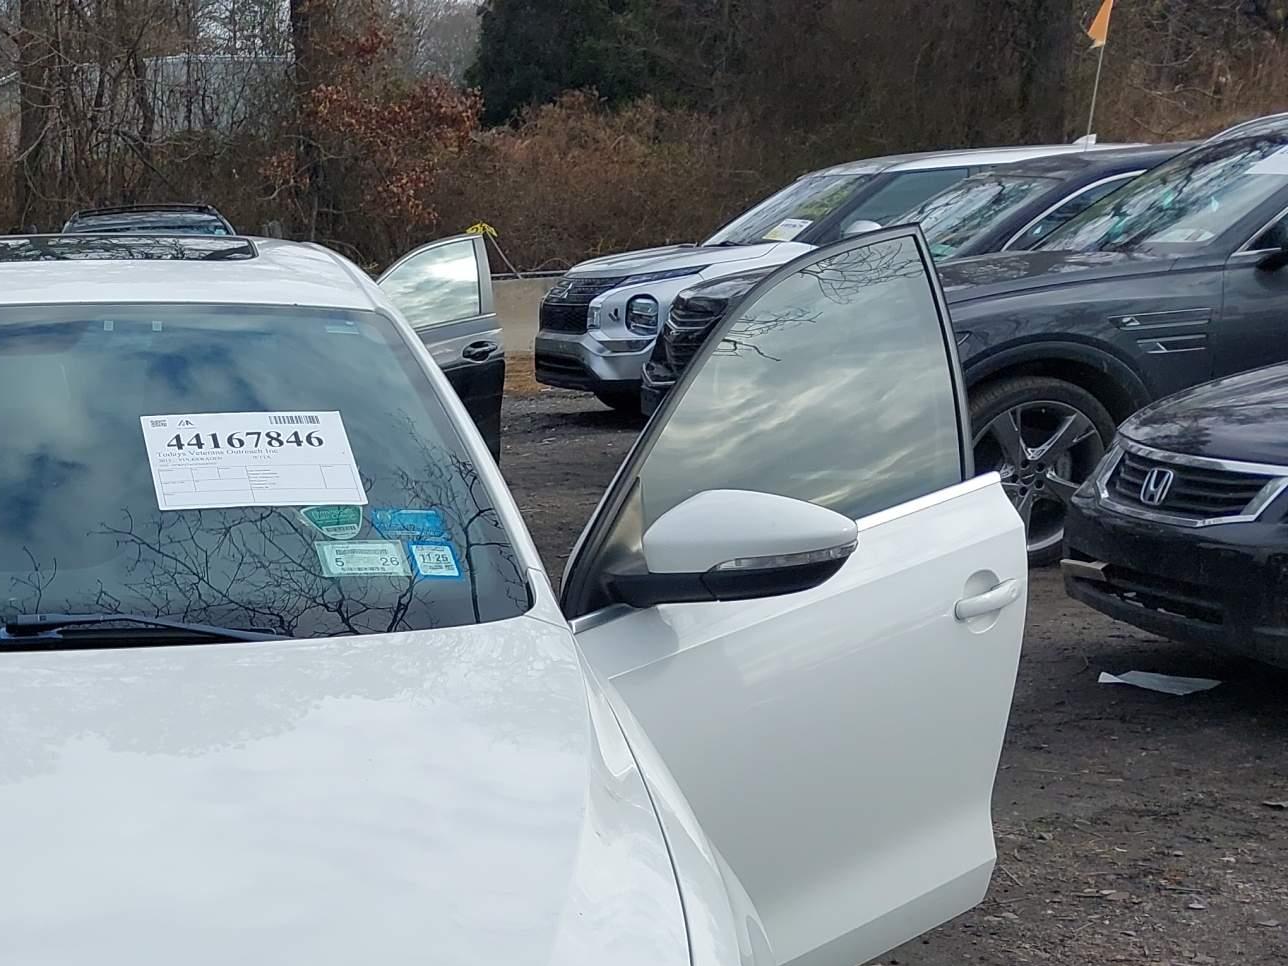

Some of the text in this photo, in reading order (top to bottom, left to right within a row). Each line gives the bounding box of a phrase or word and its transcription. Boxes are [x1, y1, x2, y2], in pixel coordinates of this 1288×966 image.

[166, 429, 324, 451] 44167846
[335, 556, 400, 567] 5 26
